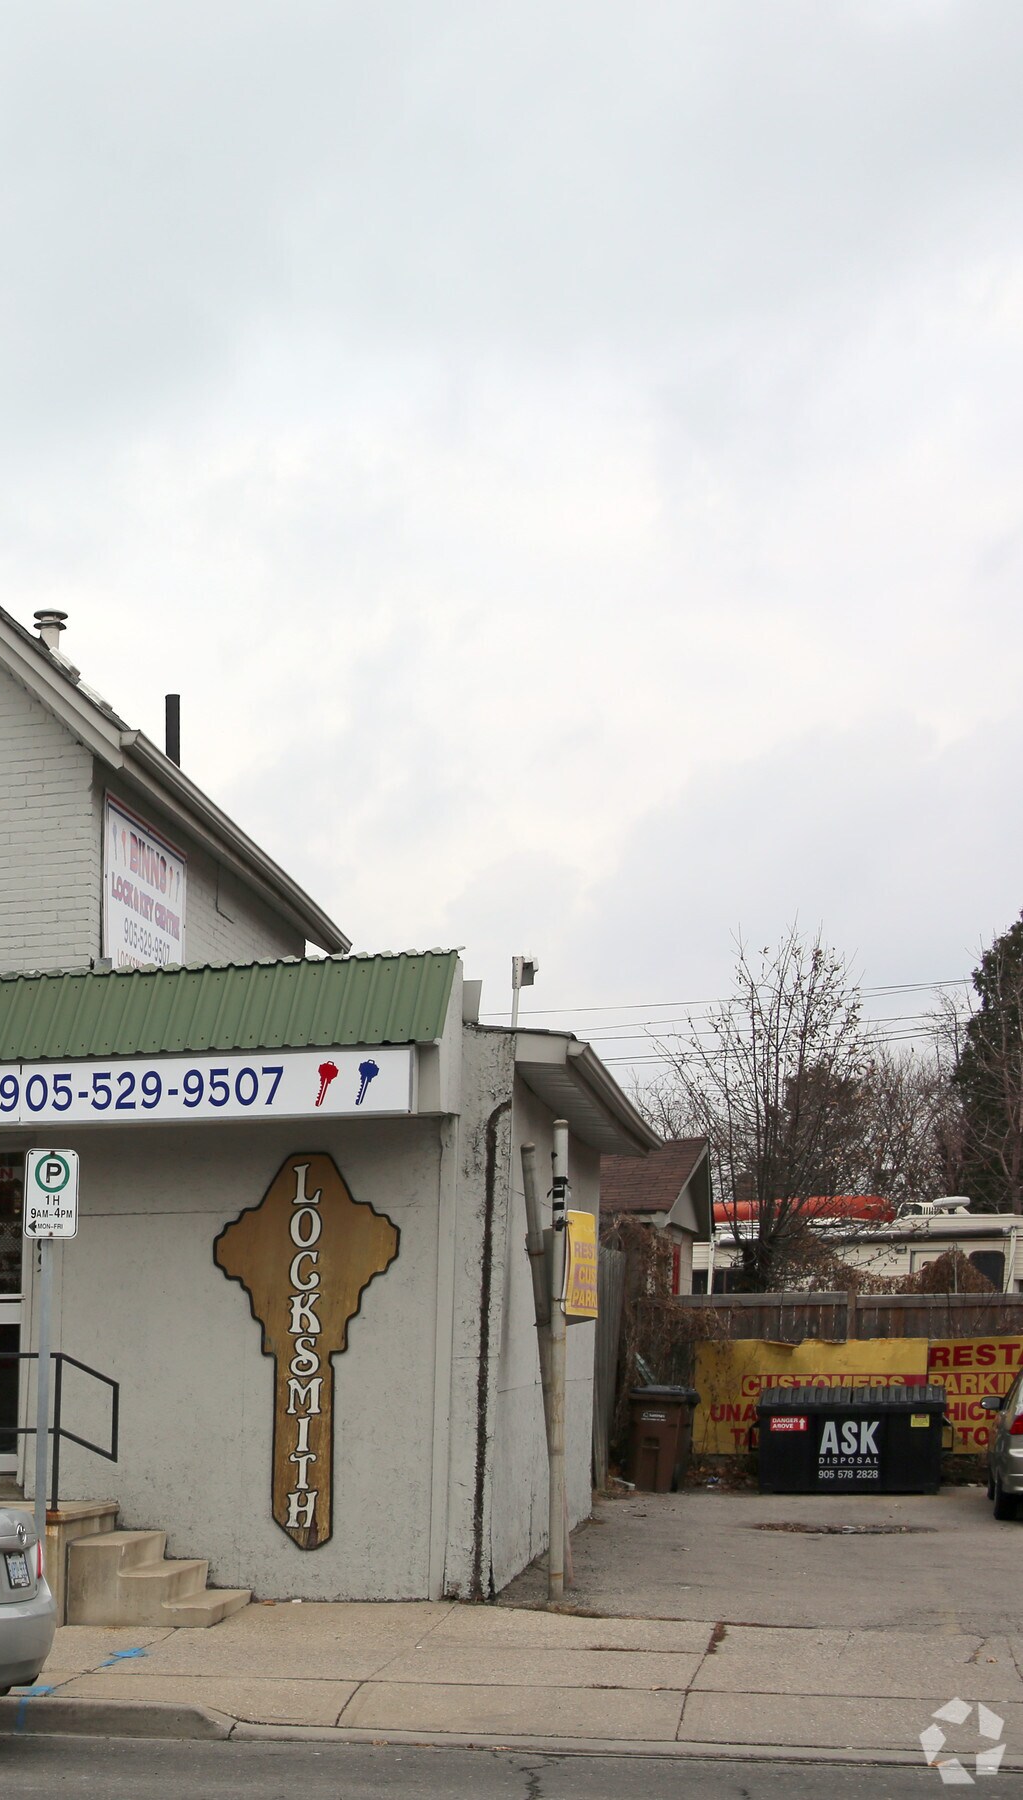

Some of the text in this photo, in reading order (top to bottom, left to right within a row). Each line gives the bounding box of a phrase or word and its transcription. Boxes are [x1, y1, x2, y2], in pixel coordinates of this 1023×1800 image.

[130, 831, 167, 894] BINNS
[154, 901, 180, 941] CENTRE
[123, 917, 171, 965] 905-529-9507
[46, 1163, 62, 1183] P
[285, 1163, 323, 1529] LOCKSMITH
[742, 1375, 905, 1396] CUSTOMERS
[819, 1421, 880, 1455] ASK
[818, 1470, 879, 1479] 905 578 2828
